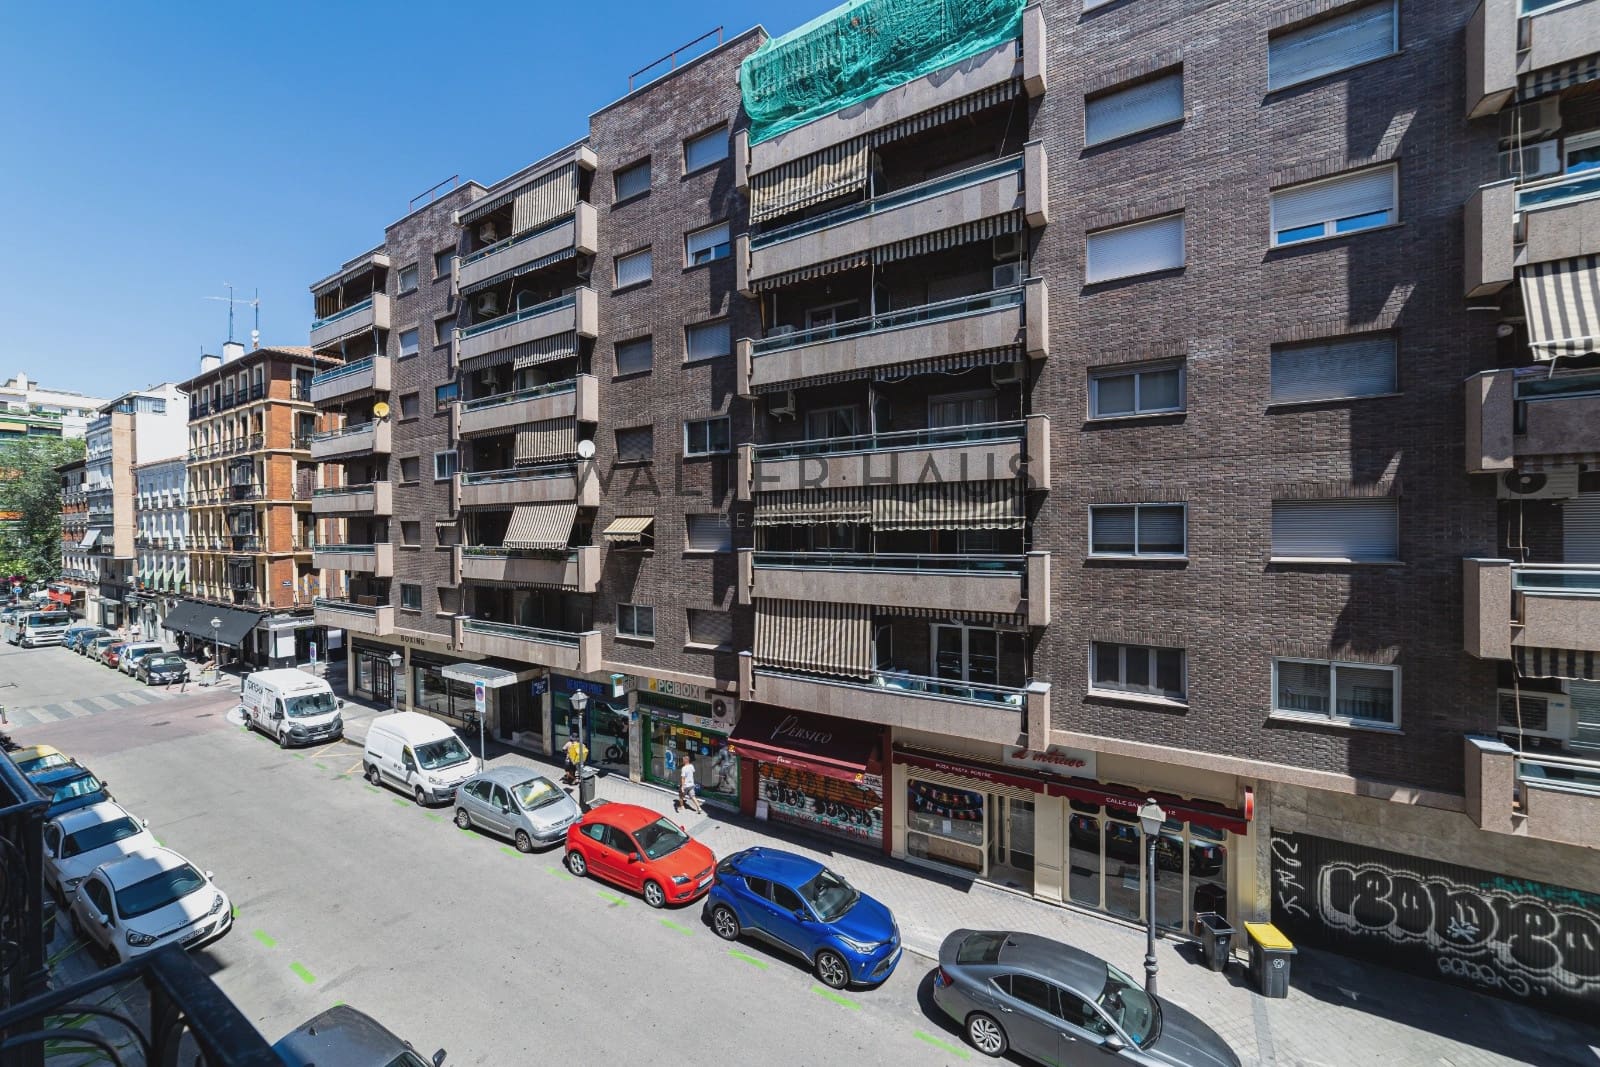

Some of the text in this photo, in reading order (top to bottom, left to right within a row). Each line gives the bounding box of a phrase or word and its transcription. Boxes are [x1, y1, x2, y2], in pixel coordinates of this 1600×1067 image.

[400, 634, 425, 646] BOXING
[657, 679, 699, 699] PCBOX
[1105, 797, 1127, 806] CALLE
